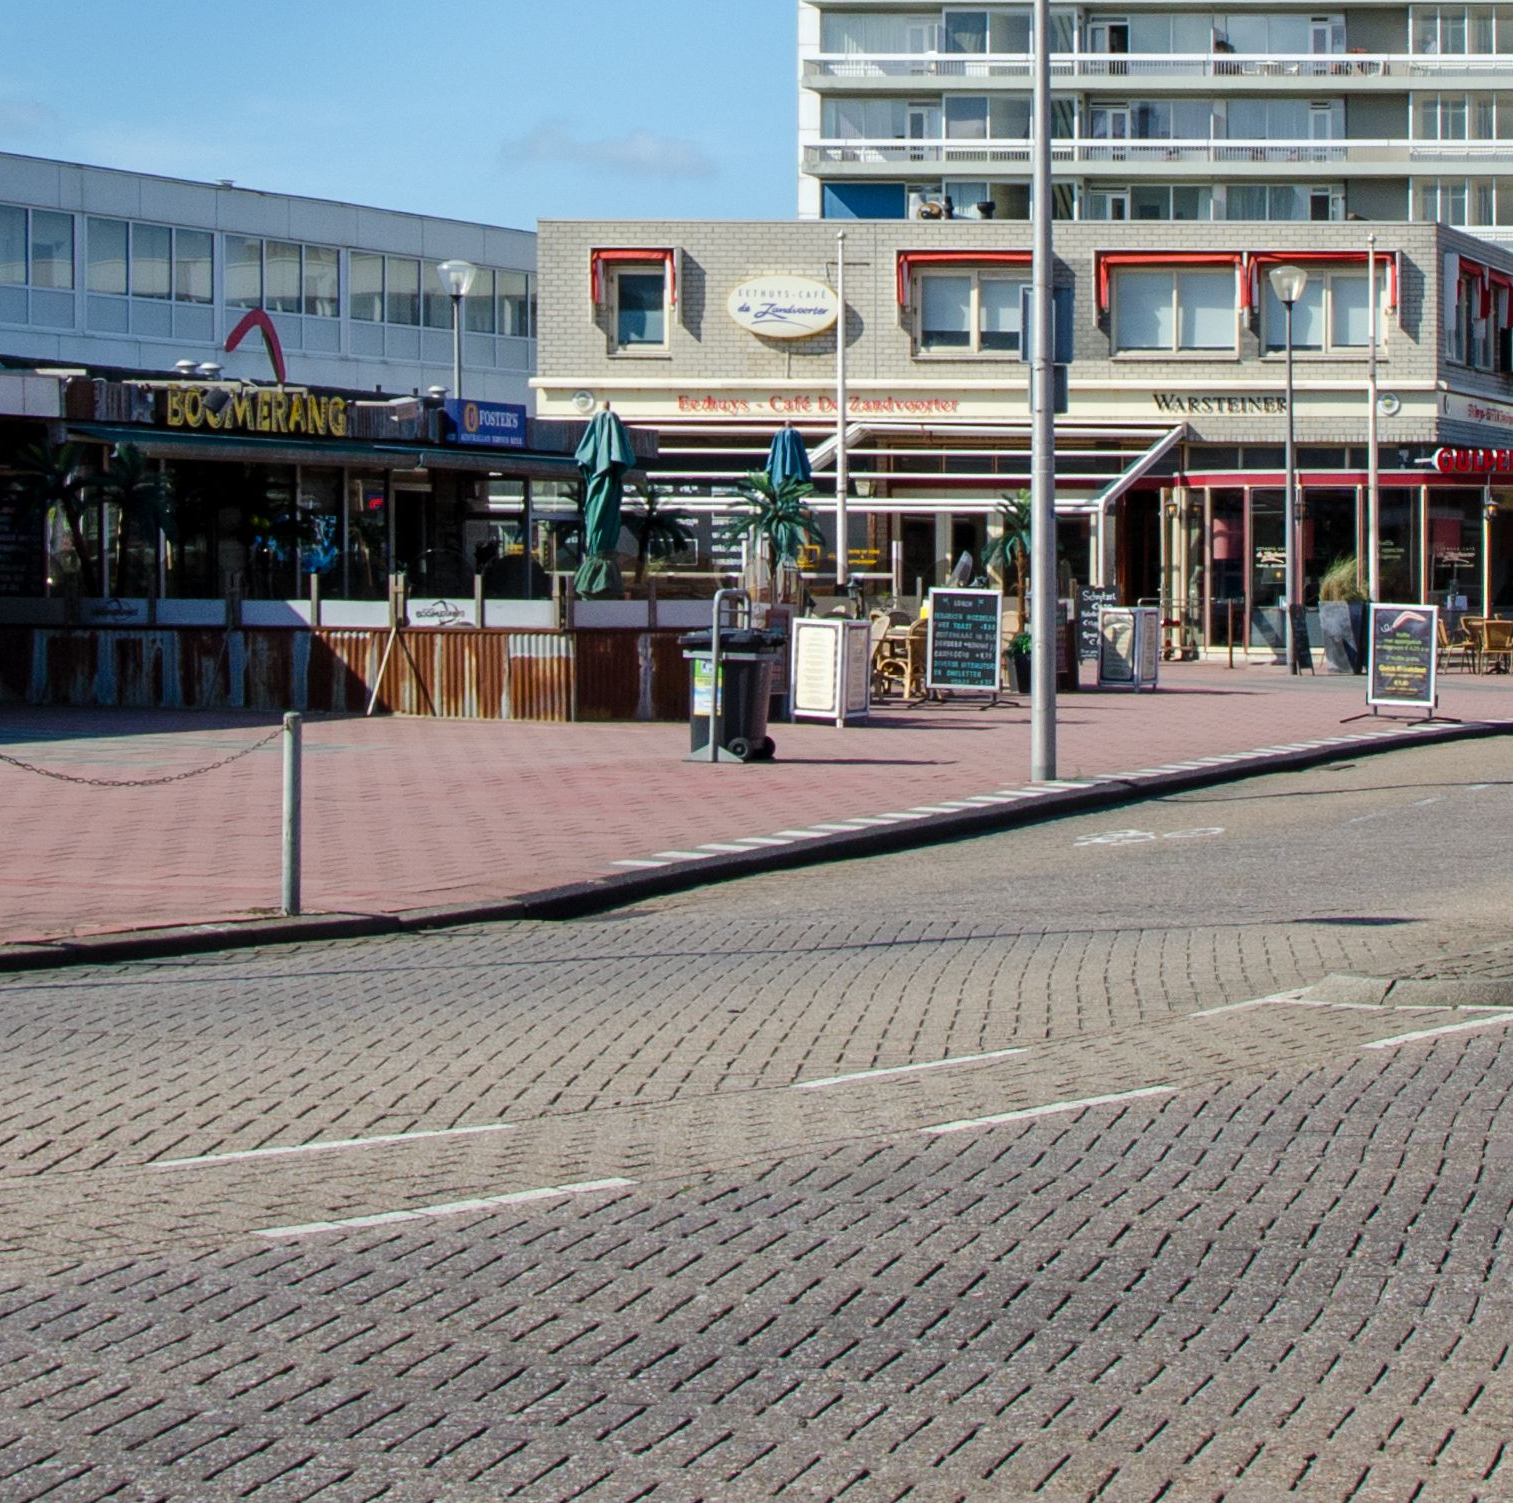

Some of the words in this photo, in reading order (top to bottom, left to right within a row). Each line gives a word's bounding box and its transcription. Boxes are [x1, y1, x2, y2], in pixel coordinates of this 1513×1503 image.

[737, 302, 752, 313] de
[753, 302, 830, 320] Zandvoorter
[769, 393, 813, 413] Café
[847, 395, 961, 414] Zandvoorter
[1152, 393, 1287, 414] WARSTEINER
